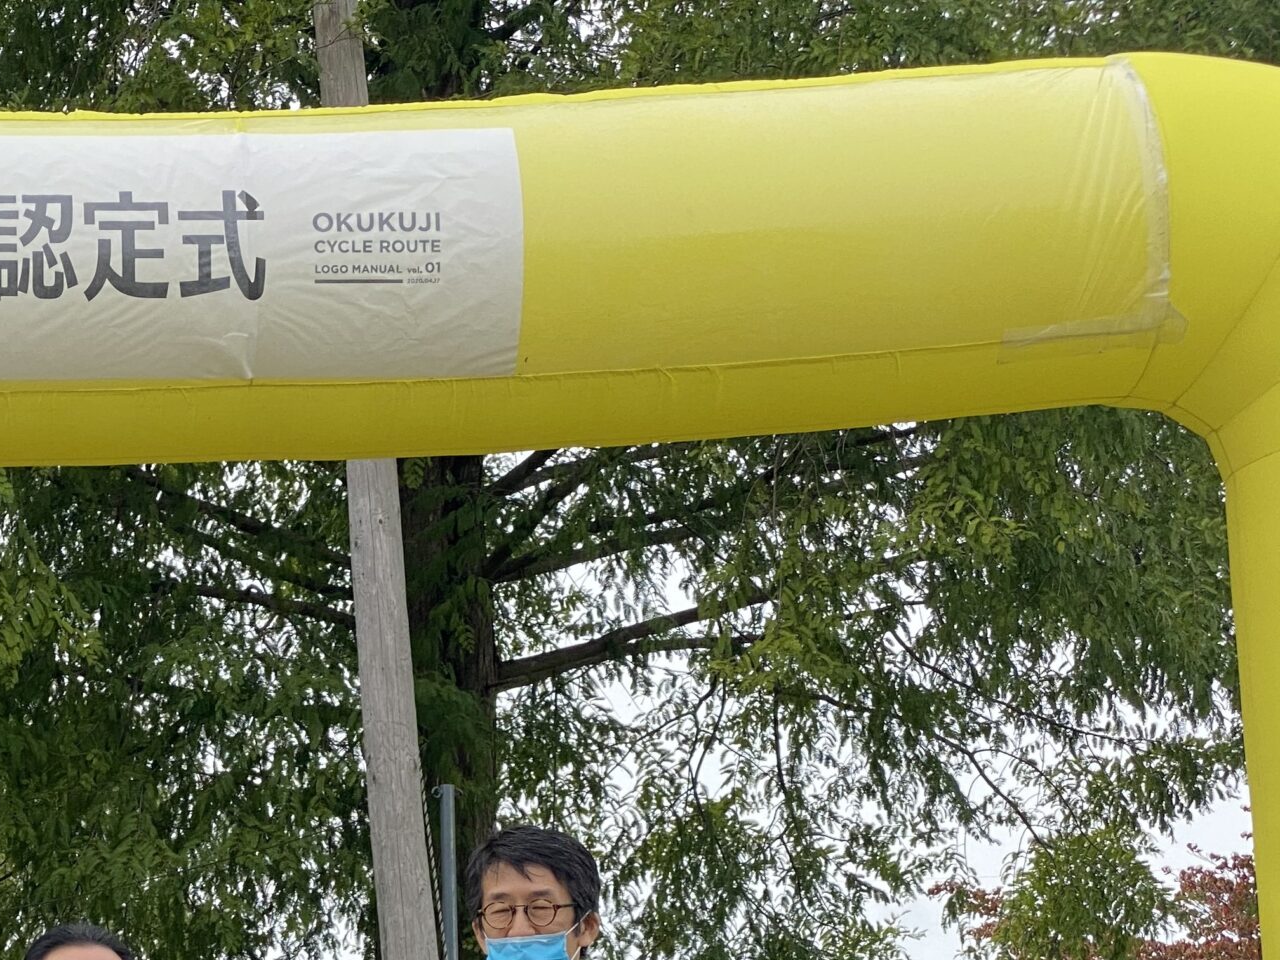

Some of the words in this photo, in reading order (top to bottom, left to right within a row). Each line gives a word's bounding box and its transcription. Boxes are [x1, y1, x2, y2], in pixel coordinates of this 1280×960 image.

[312, 211, 441, 233] OKUKUJI
[314, 240, 373, 253] CYCLE
[379, 240, 441, 253] ROUTE
[315, 264, 349, 274] LOGO
[352, 264, 403, 274] MANUAL
[425, 261, 441, 273] 01
